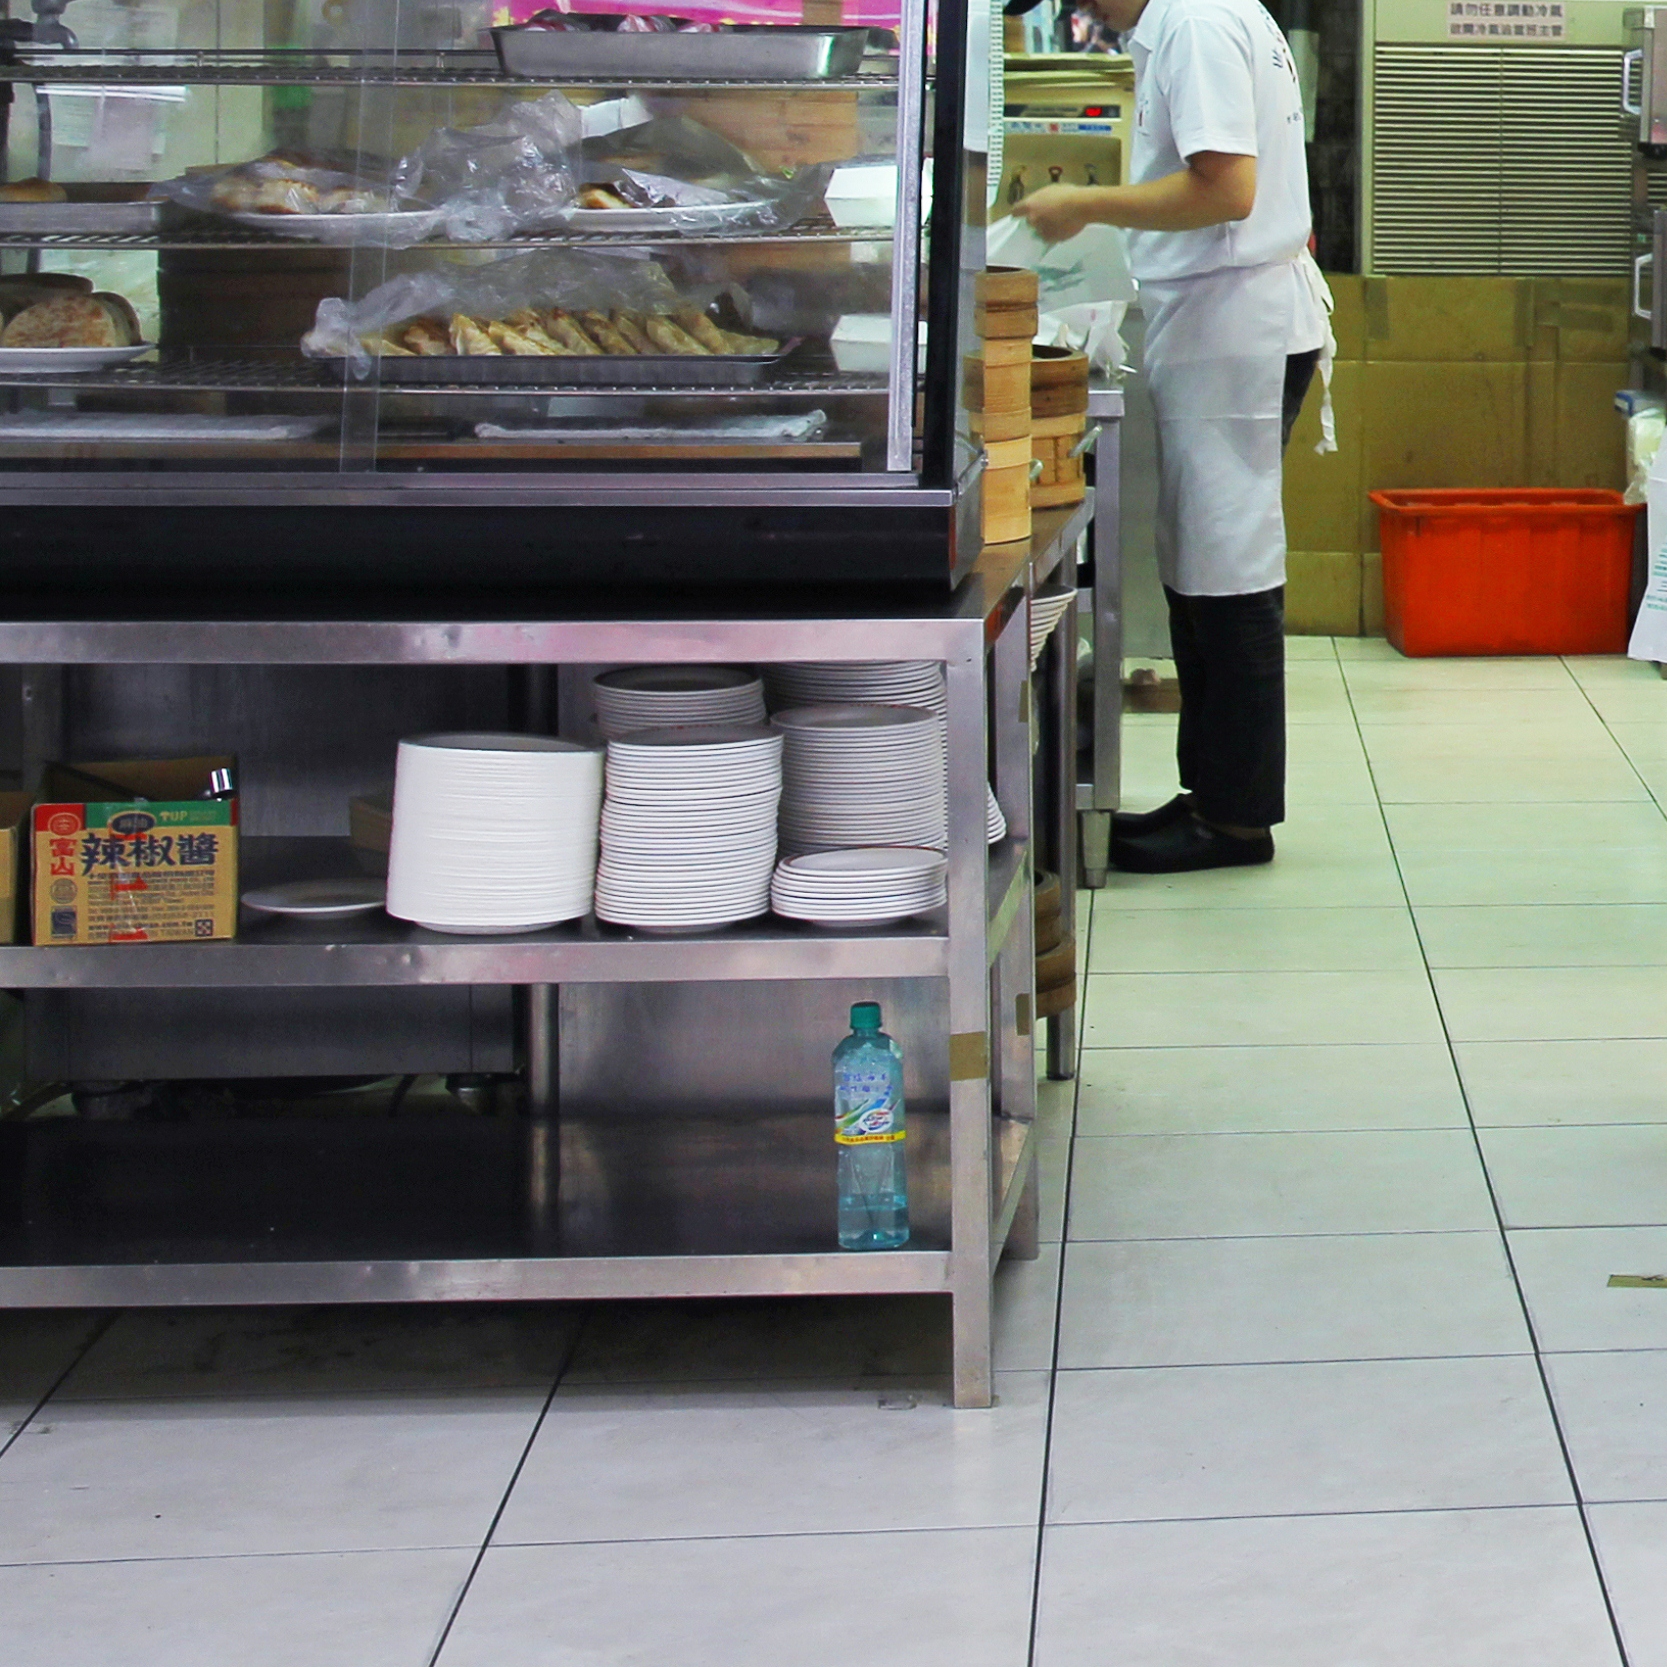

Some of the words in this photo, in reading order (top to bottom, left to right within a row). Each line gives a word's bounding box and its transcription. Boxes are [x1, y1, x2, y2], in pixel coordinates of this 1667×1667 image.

[49, 837, 78, 876] 富山
[81, 831, 219, 876] 辣椒醬
